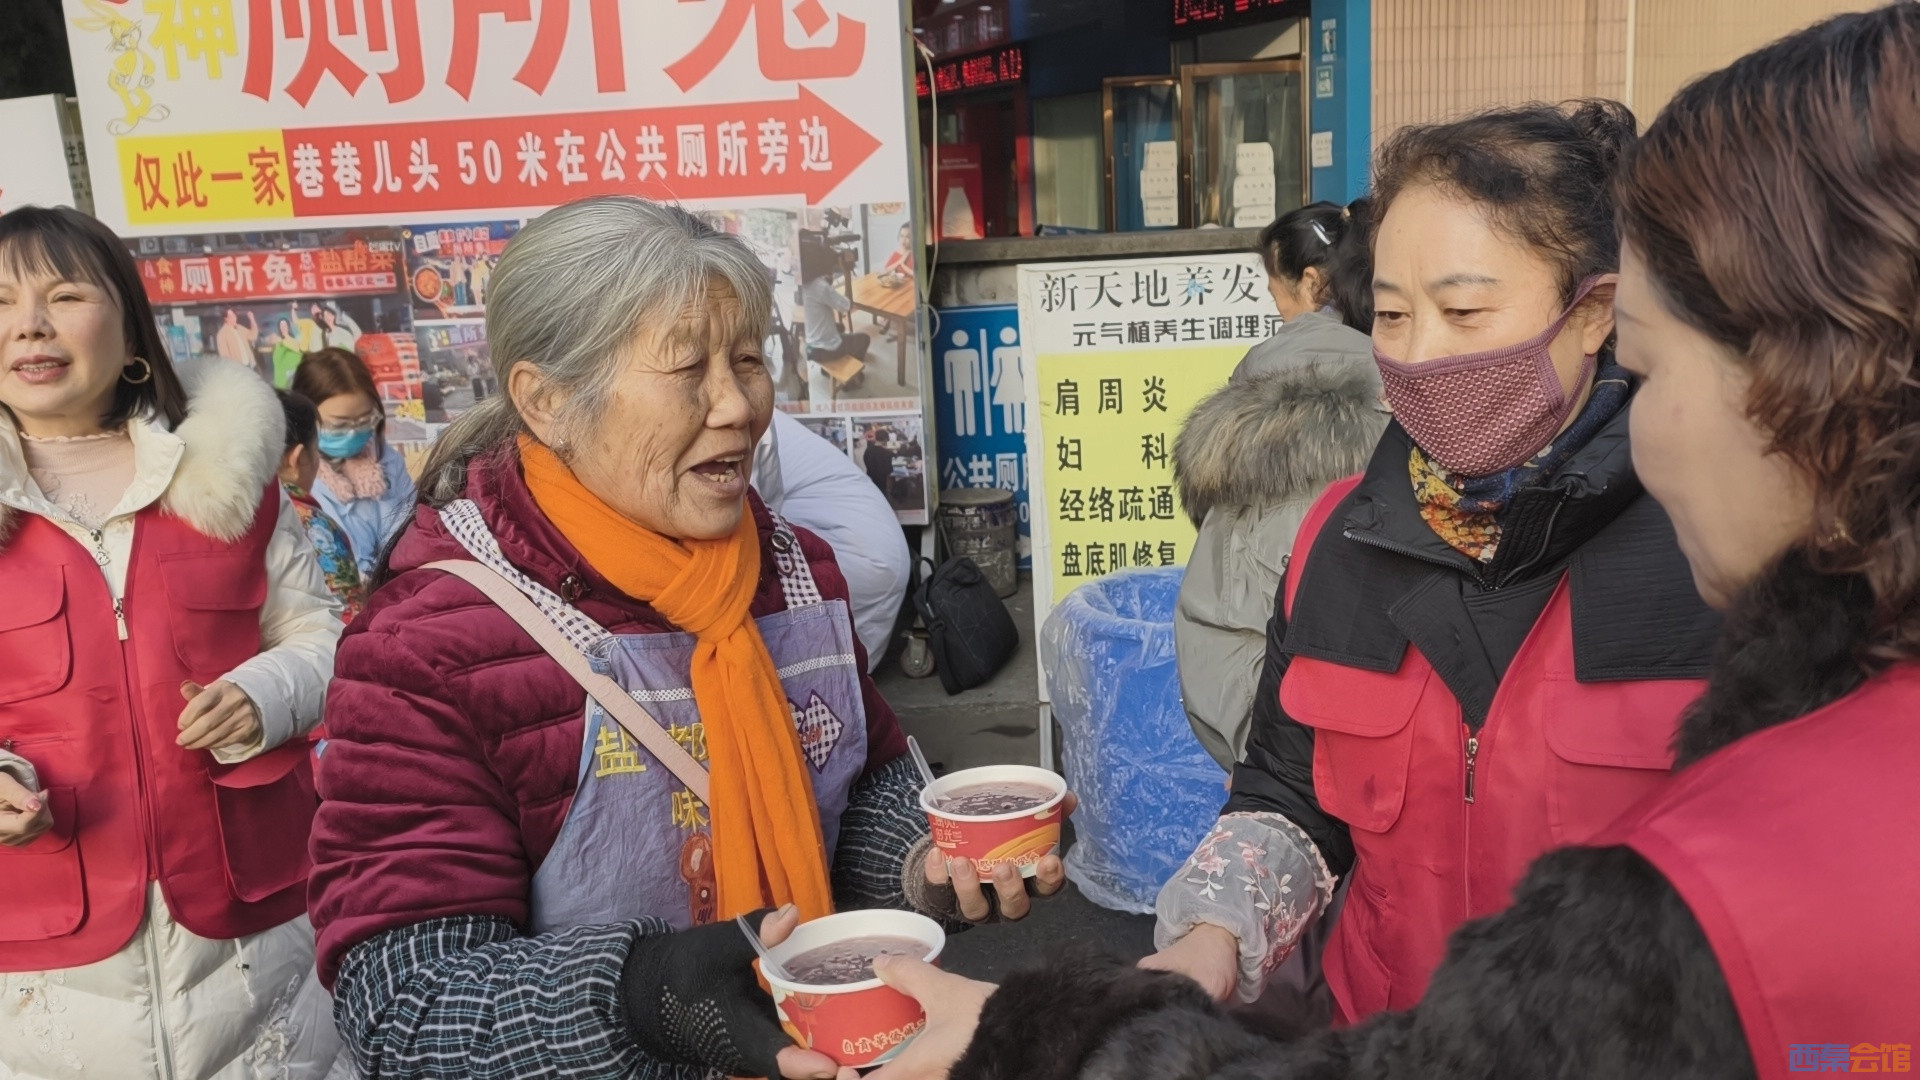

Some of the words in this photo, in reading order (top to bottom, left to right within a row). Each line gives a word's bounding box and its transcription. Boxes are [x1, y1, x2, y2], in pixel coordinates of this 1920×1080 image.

[133, 146, 287, 211] 仅此一家
[180, 253, 298, 295] 厕所兔
[1039, 263, 1261, 313] 新天地养发
[1056, 376, 1168, 416] 肩周炎
[943, 452, 1027, 492] 公共厕
[1057, 433, 1169, 472] 妇科
[1059, 485, 1176, 522] 经络疏通
[1061, 540, 1176, 577] 盘底肌修复
